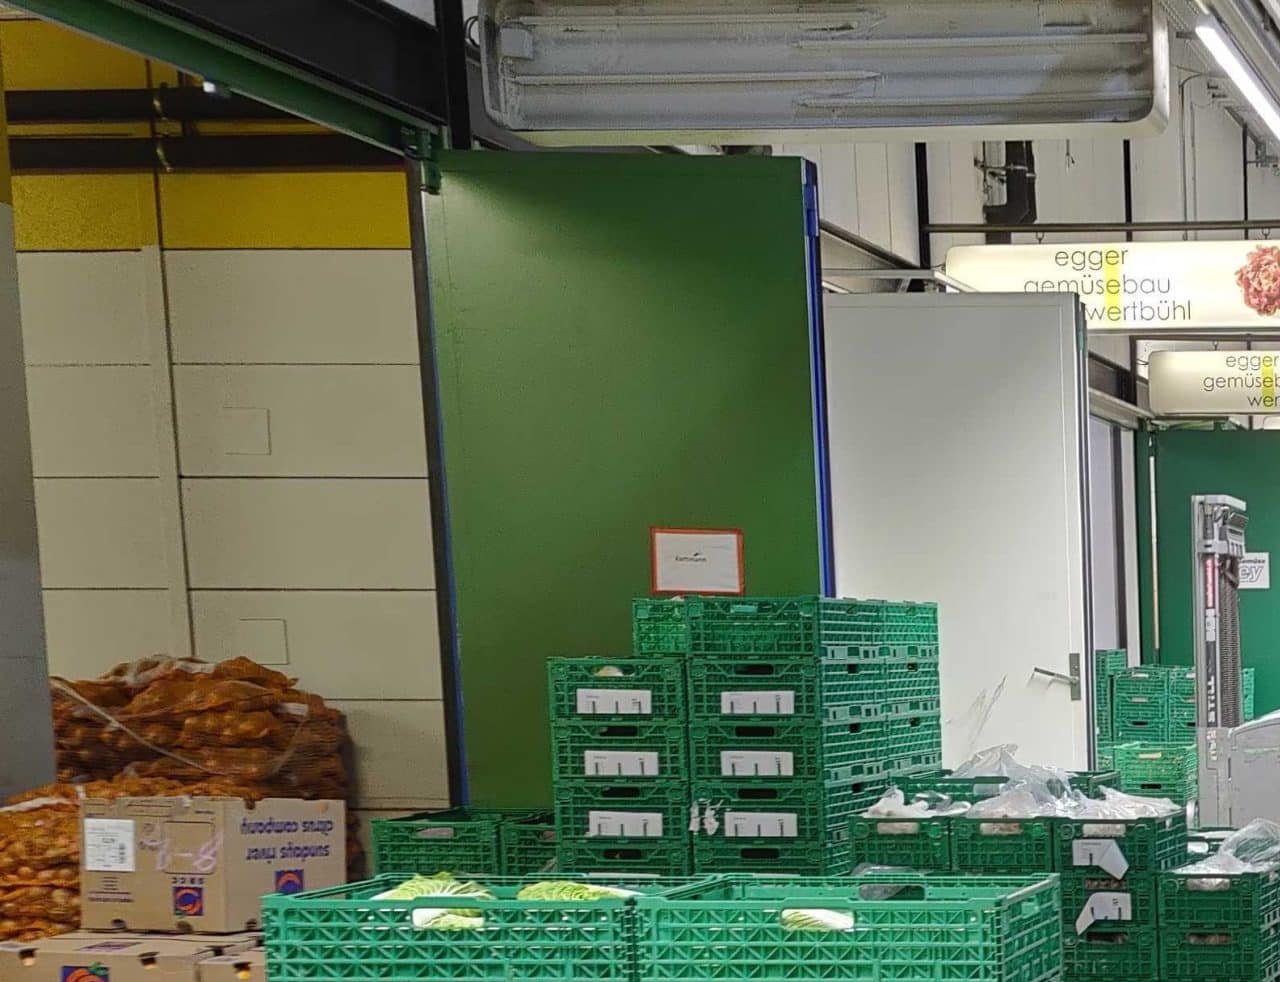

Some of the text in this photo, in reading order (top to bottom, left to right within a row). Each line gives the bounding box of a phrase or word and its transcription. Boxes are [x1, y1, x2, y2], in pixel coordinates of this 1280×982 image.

[1055, 248, 1129, 271] egger
[1024, 274, 1170, 294] gemüsebau
[1086, 300, 1191, 321] wertbühl
[1226, 355, 1279, 371] egger
